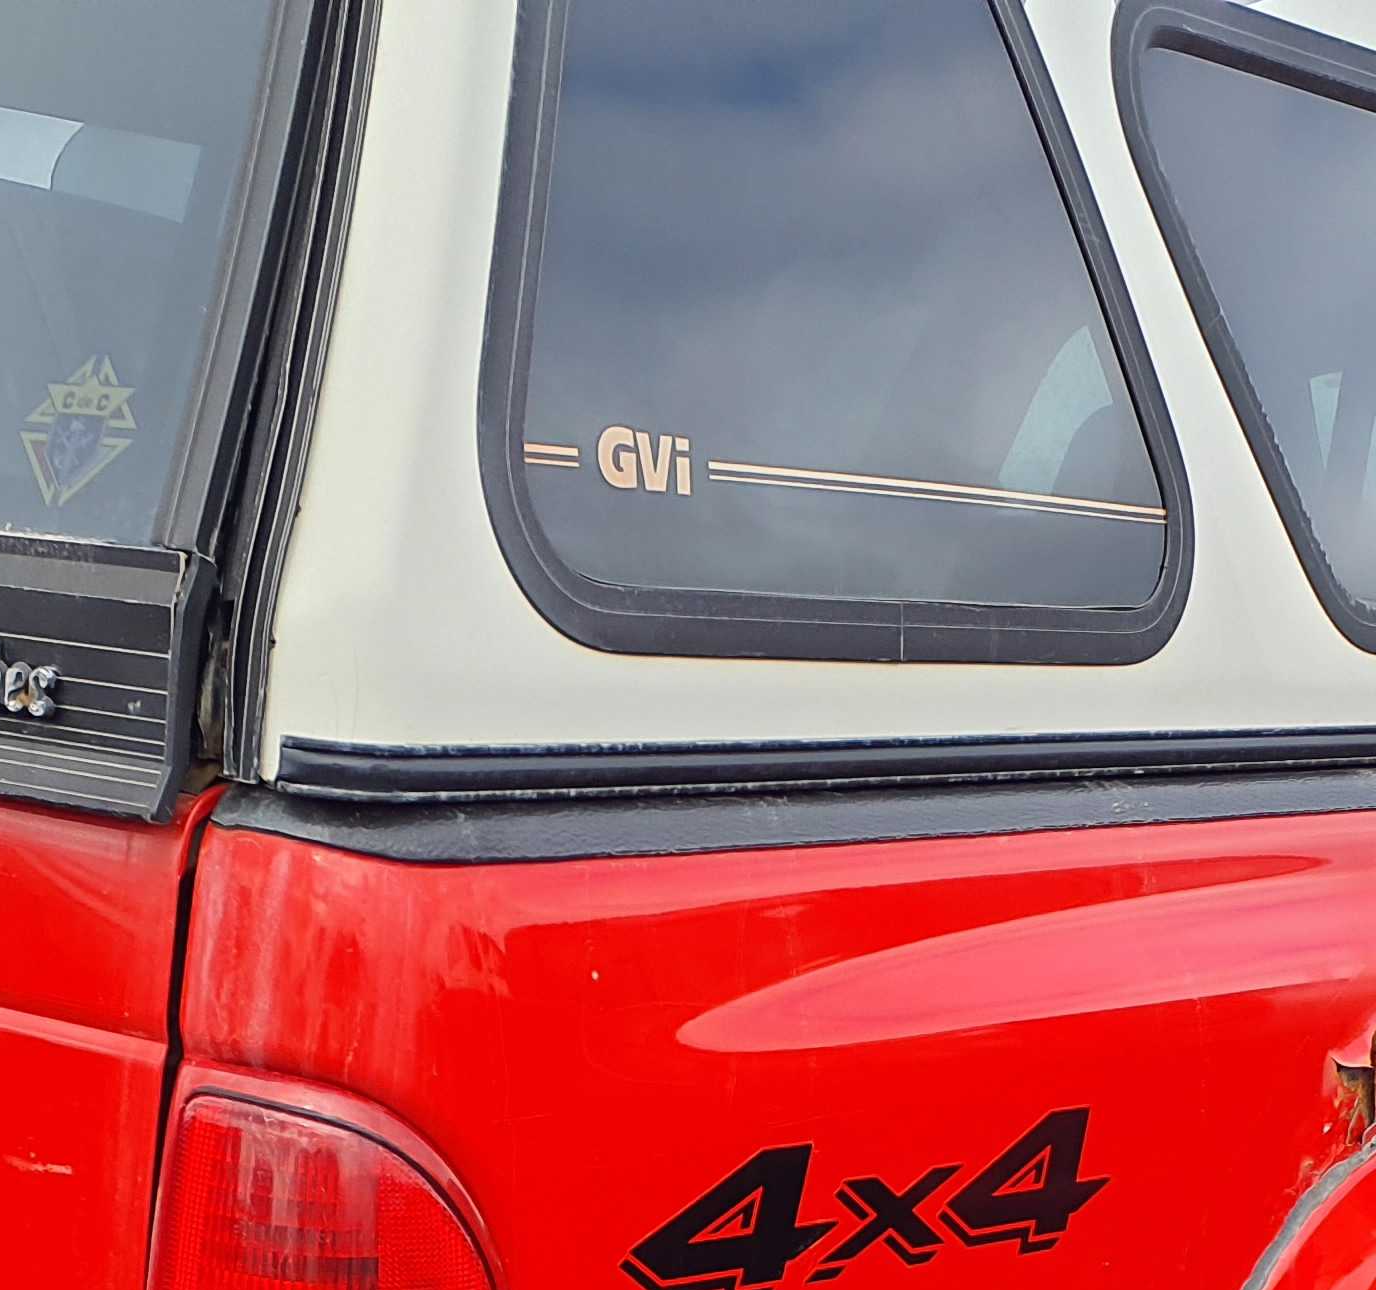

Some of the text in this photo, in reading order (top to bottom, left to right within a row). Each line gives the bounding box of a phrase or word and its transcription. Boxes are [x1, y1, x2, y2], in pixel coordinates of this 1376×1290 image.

[62, 390, 77, 410] C
[95, 394, 111, 411] C
[597, 425, 692, 497] GVi
